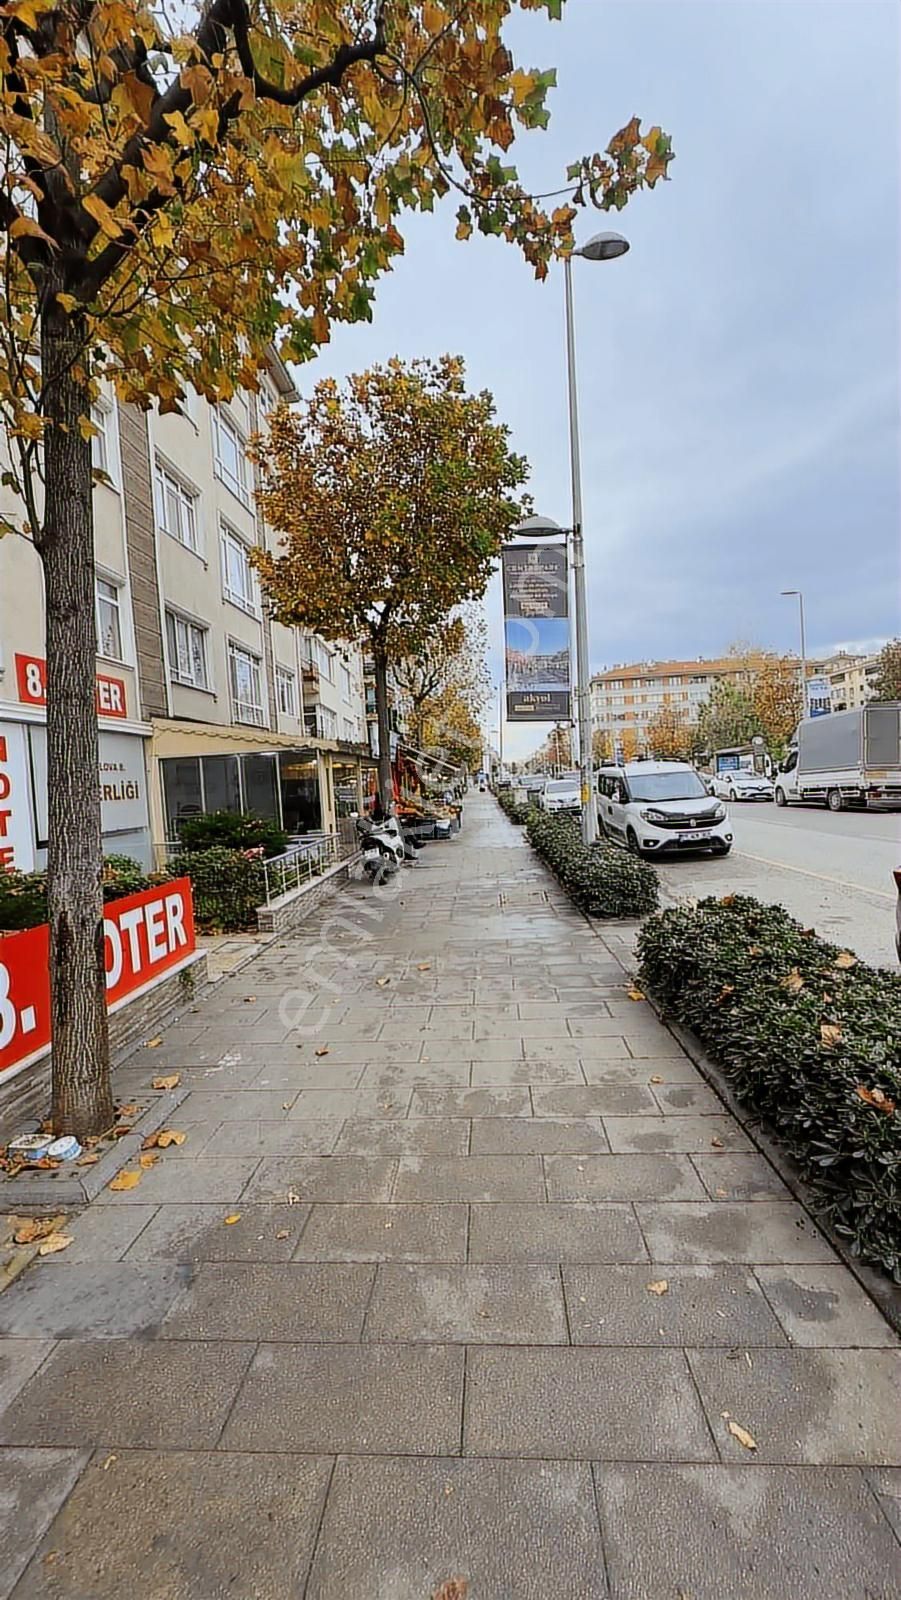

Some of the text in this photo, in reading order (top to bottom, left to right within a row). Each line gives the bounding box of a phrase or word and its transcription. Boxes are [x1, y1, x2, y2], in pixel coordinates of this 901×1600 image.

[26, 663, 122, 712] 8. ER
[104, 893, 187, 990] OTER
